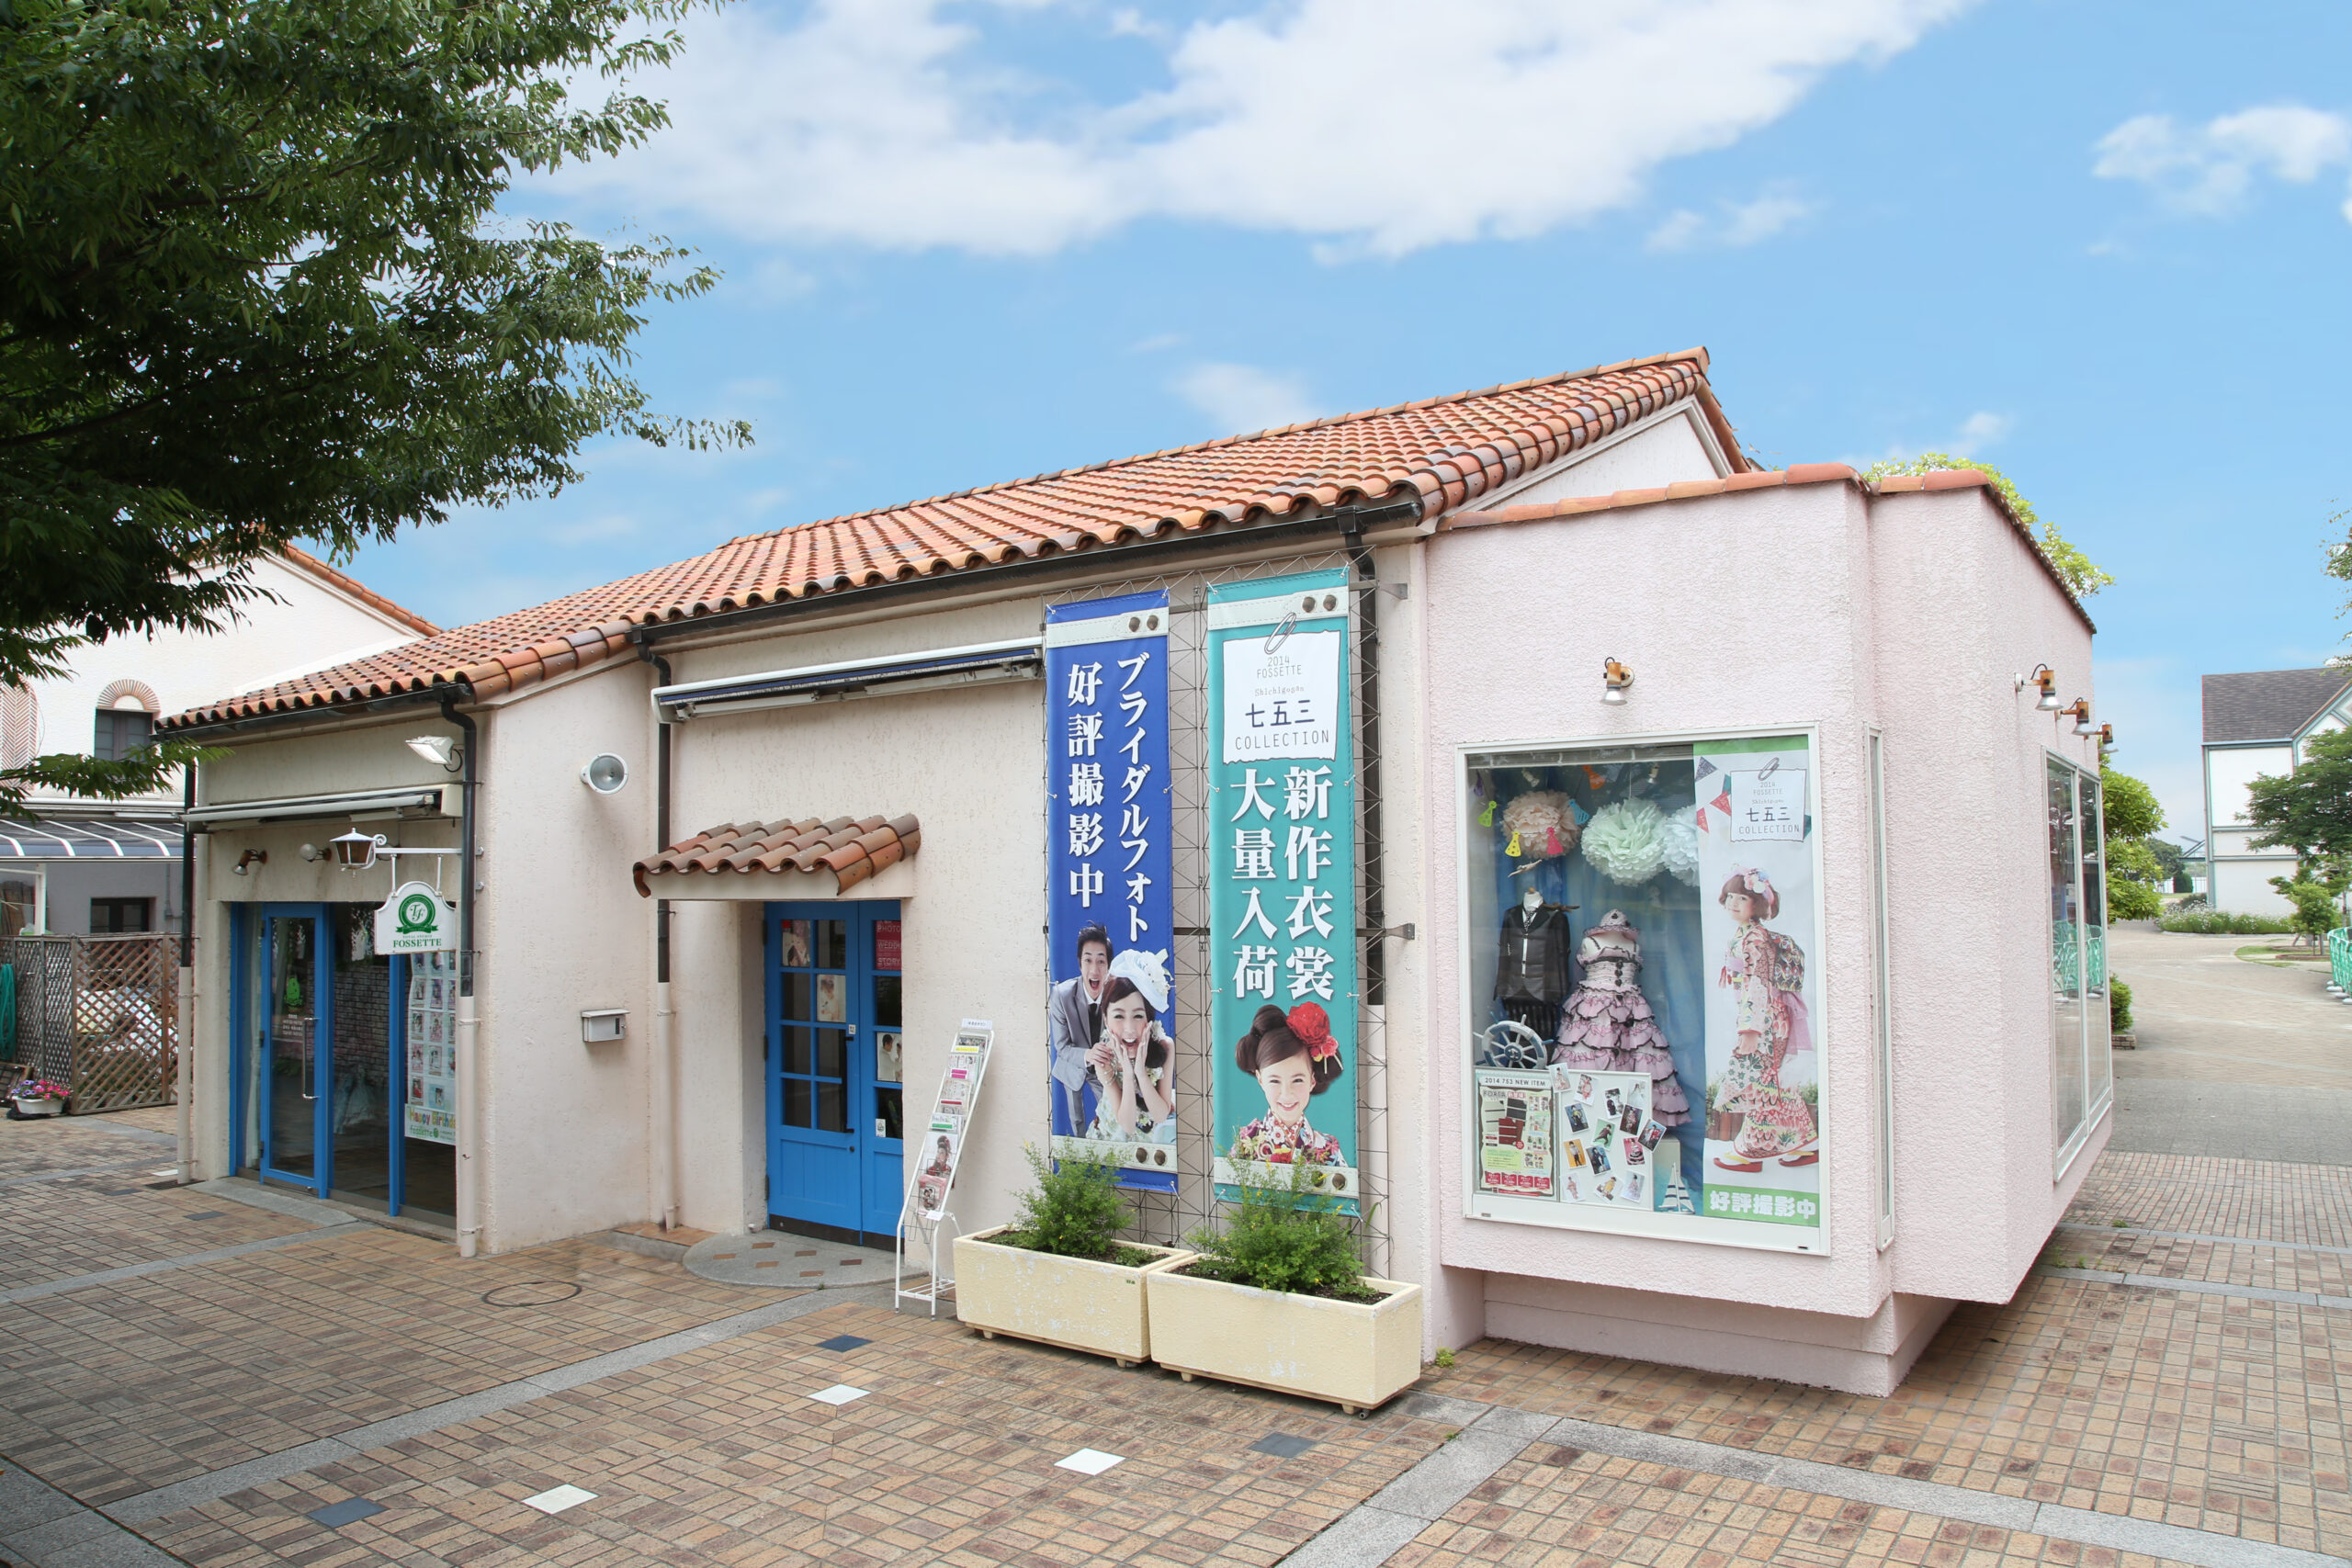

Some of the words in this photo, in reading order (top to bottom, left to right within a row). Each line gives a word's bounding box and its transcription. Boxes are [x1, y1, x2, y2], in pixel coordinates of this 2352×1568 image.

[1257, 664, 1302, 679] FOSSETTE
[1267, 655, 1290, 668] 2014
[1245, 699, 1315, 728] 七五三
[1235, 729, 1329, 750] COLLECTION
[1068, 661, 1104, 908] 好評撮影中
[1117, 651, 1151, 942] ブライダルフォト
[1746, 807, 1791, 822] 七五三
[1738, 824, 1800, 834] COLLECTION
[1230, 768, 1278, 999] 大量入荷
[1283, 764, 1334, 1001] 新作衣裳
[393, 938, 442, 948] FOSSETTE
[1710, 1190, 1816, 1220] 好評撮影中
